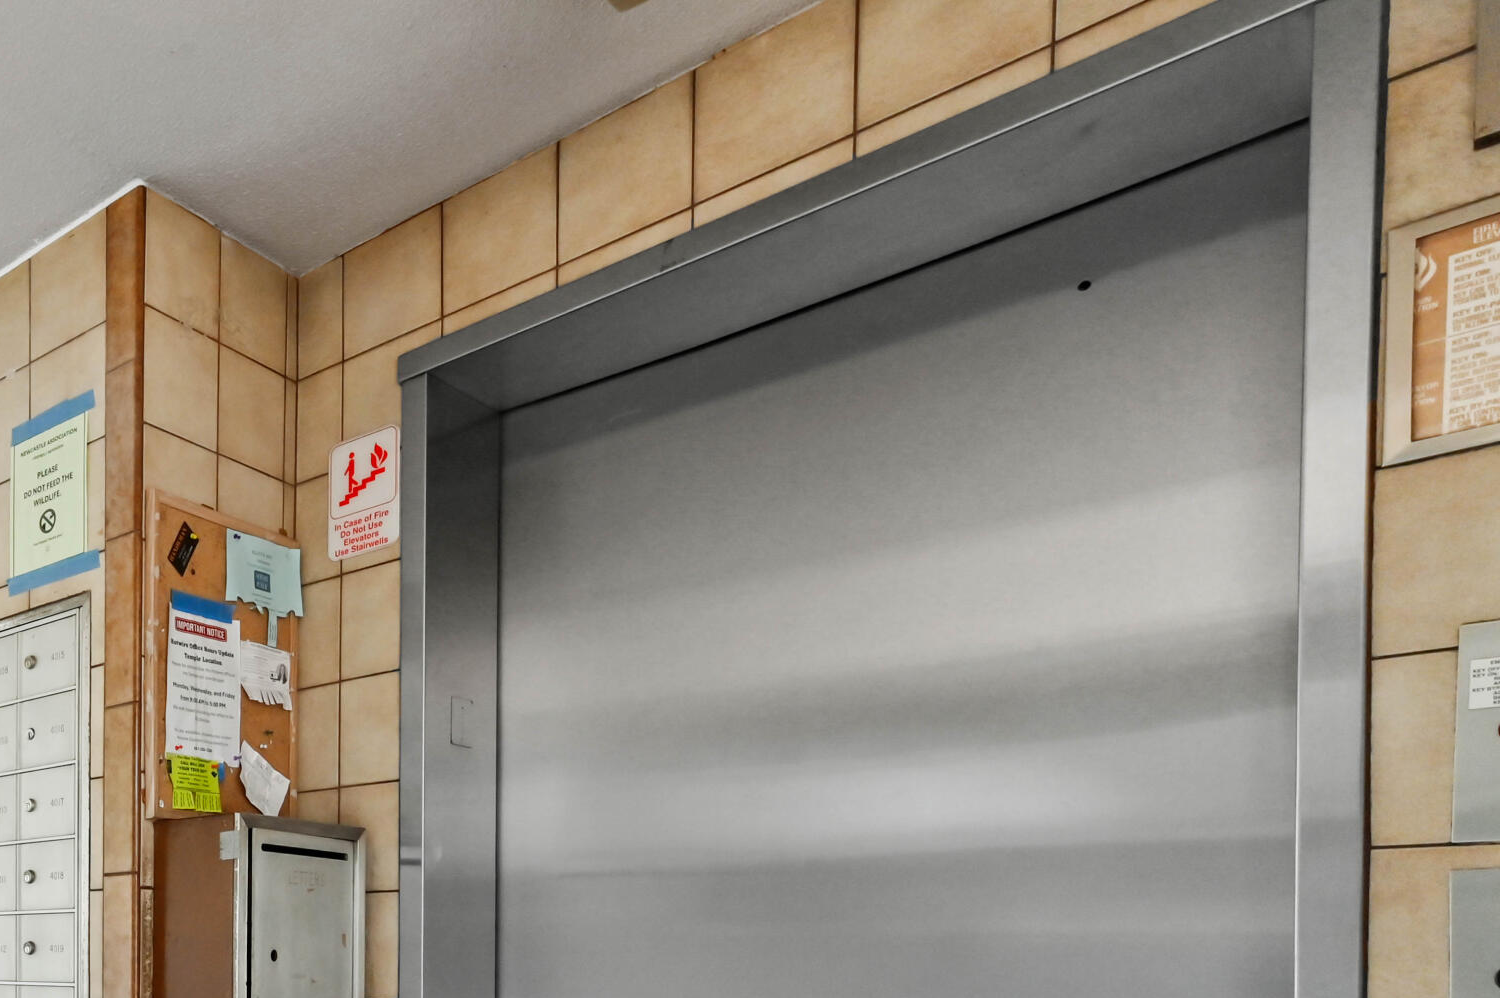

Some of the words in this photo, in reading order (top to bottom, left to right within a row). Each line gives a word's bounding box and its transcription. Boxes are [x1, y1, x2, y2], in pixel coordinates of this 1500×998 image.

[37, 463, 58, 479] PLEASE
[23, 489, 32, 499] DO
[32, 483, 46, 495] NOT
[46, 477, 60, 490] FEED
[61, 471, 74, 483] THE
[344, 518, 362, 529] Case
[364, 514, 372, 522] of
[374, 510, 389, 519] Fire
[340, 530, 350, 538] Do
[352, 524, 366, 534] Not
[368, 520, 383, 530] Use
[344, 530, 379, 546] Elevators
[334, 549, 349, 557] Use
[351, 536, 388, 552] Stairwells
[176, 620, 206, 634] IMPORTANT
[206, 628, 224, 640] NOTICE
[190, 642, 203, 651] Office
[218, 650, 234, 658] Update
[184, 652, 201, 662] Temple
[202, 656, 222, 666] Location
[222, 692, 235, 700] Friday
[50, 798, 64, 807] 4017
[50, 872, 64, 880] 4018
[50, 944, 64, 953] 4019
